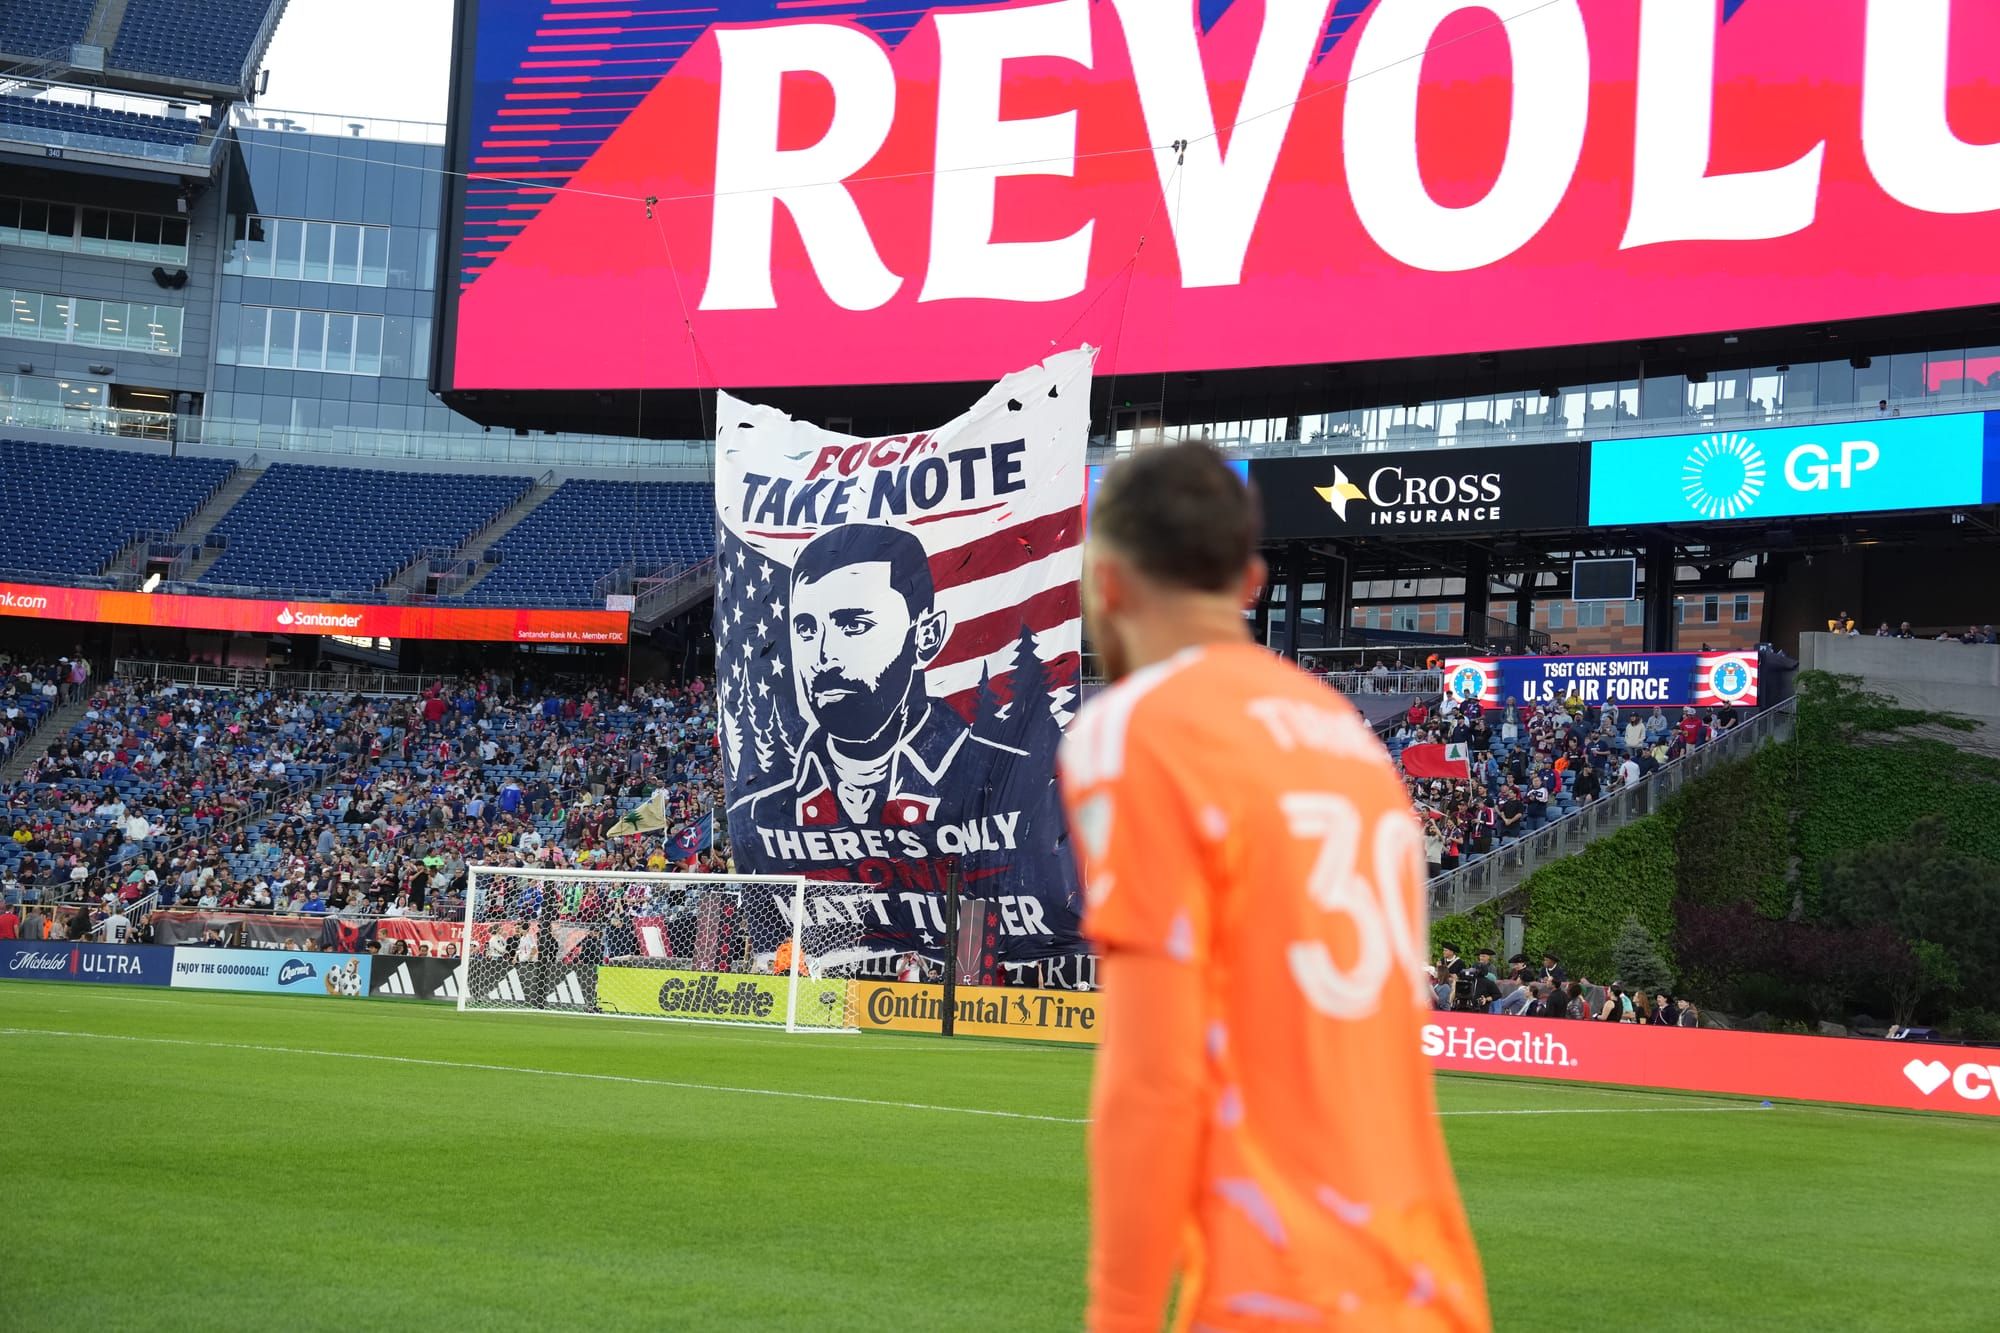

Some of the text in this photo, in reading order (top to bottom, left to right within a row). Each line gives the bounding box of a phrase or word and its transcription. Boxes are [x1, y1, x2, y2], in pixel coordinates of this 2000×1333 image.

[48, 148, 60, 157] 340
[742, 438, 1027, 527] TAKE NOTE
[1371, 506, 1501, 525] INSURANCE
[294, 611, 362, 628] Santander
[518, 630, 549, 639] Santander
[550, 632, 566, 640] Bank
[1543, 661, 1649, 678] TSGT GENE SMITH
[1523, 677, 1670, 701] U.S AIR FORCE
[756, 810, 1021, 861] THERE'S ONLY
[899, 892, 1055, 936] TUER
[9, 951, 142, 975] Michelob ULTRA
[176, 962, 200, 976] ENJOY
[201, 963, 215, 974] THE
[658, 975, 774, 1018] Gillette
[868, 986, 1096, 1030] Continntal Tire
